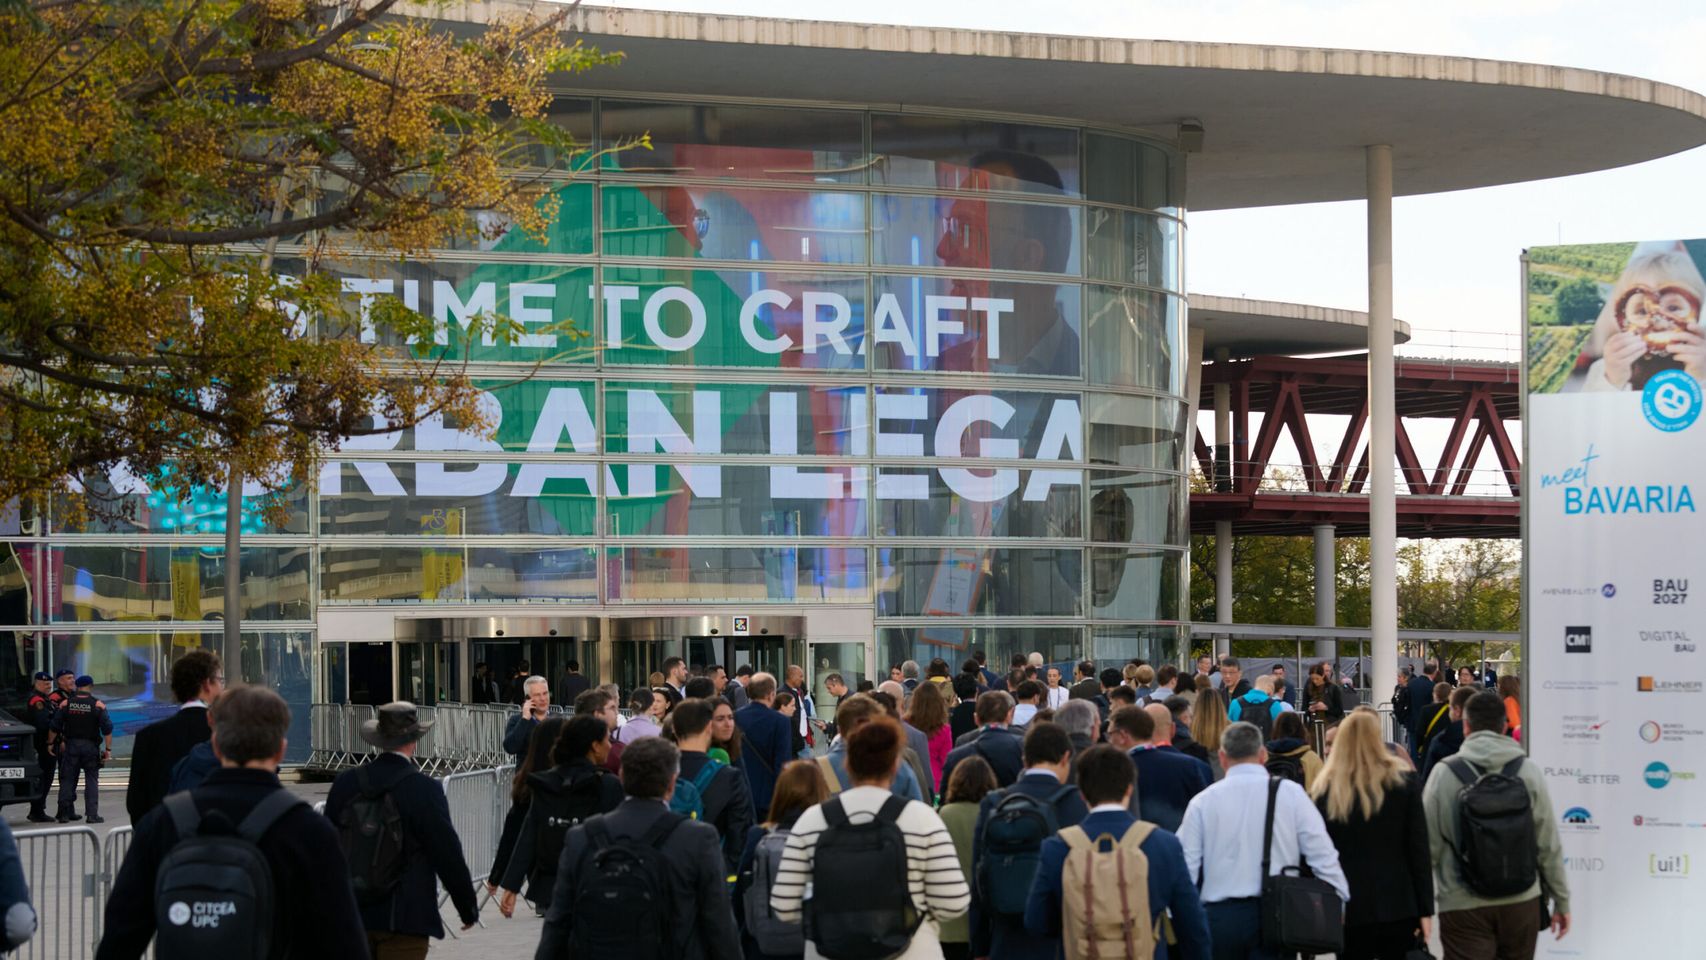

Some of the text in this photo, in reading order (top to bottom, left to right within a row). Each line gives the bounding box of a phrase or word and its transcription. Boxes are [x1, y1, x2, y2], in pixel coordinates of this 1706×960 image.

[341, 277, 557, 348] TIME
[589, 285, 707, 352] TO
[739, 288, 1015, 360] CRAFT
[769, 390, 1081, 501] LEGA
[1540, 443, 1600, 488] meet
[1564, 485, 1696, 515] BAVARIA
[1653, 579, 1688, 592] BAU
[1653, 593, 1688, 604] 2027
[1639, 630, 1690, 642] DIGITAL
[1674, 643, 1696, 653] BAU
[192, 901, 237, 915] CITCEA
[192, 915, 220, 928] UPC
